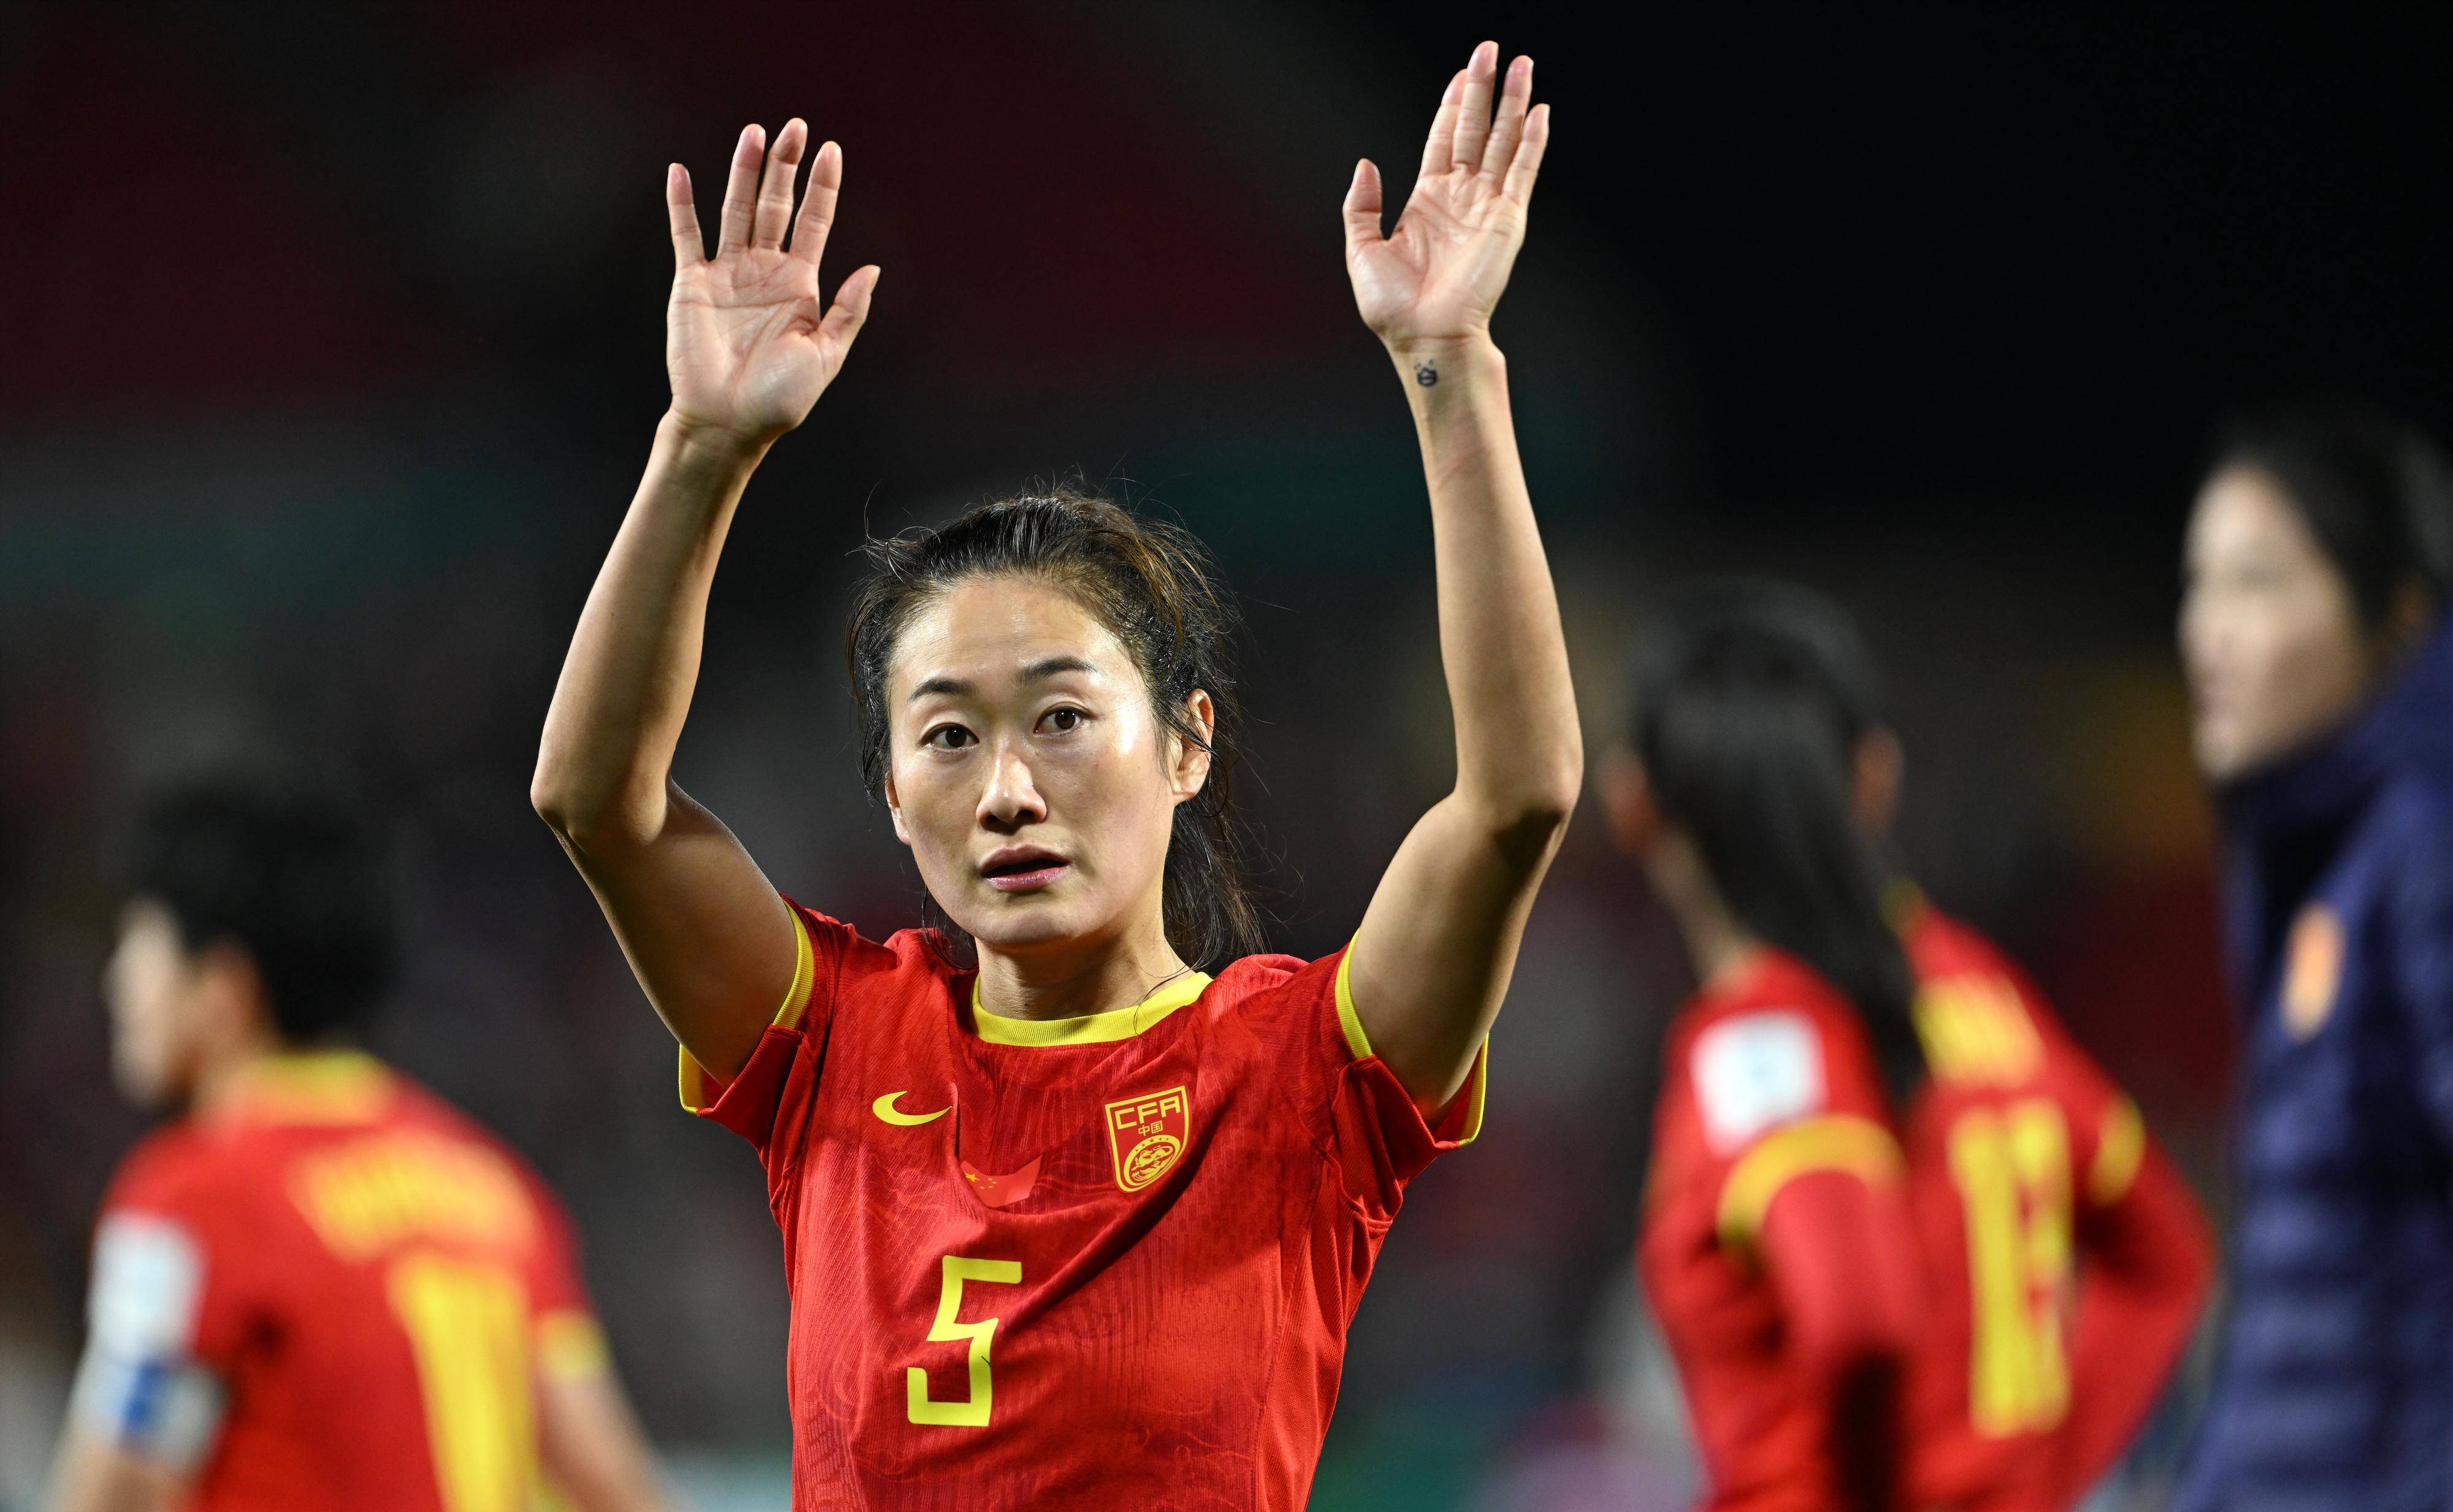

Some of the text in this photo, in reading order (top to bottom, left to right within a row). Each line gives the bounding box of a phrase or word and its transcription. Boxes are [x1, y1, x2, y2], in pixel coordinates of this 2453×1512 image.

[1114, 1095, 1181, 1130] CFA
[1138, 1120, 1163, 1137] 中国
[907, 1254, 1022, 1427] 5
